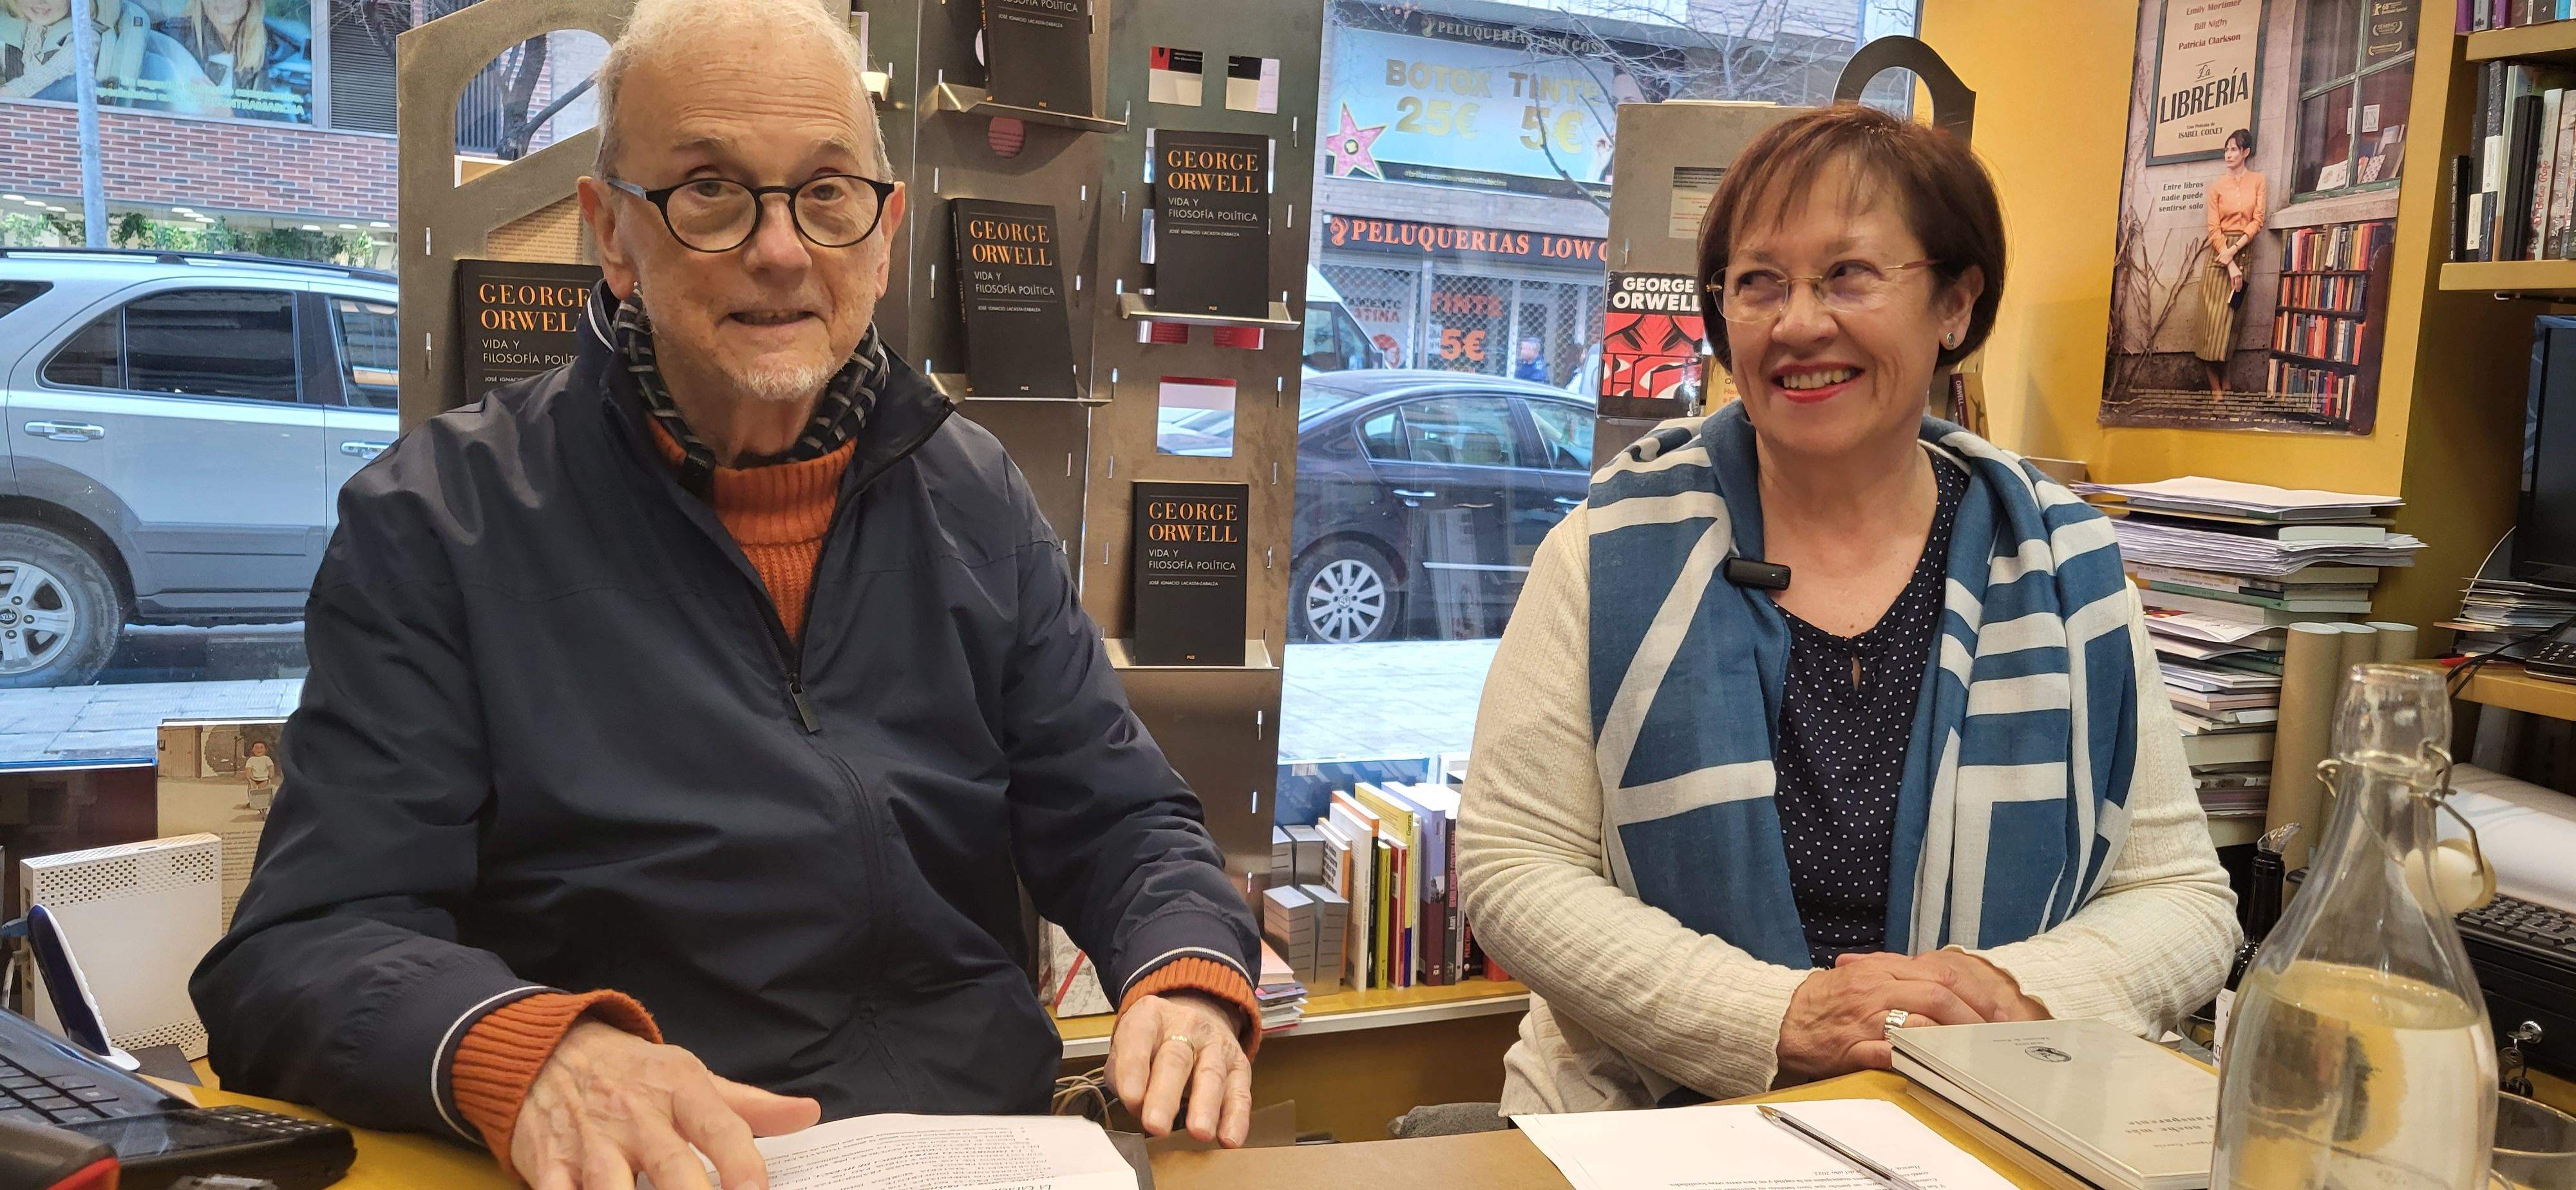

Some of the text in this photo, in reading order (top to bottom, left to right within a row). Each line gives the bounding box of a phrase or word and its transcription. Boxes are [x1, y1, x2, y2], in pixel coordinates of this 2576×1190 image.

[1042, 0, 1079, 13] POLÍTICA
[2186, 0, 2242, 15] Emily Mortimer
[2194, 18, 2228, 31] Bill Nighy
[1571, 39, 1604, 54] COS
[2179, 33, 2241, 51] Patricia Clarkson
[2197, 64, 2211, 79] La
[1386, 59, 1602, 108] BOTOX TINTE
[2159, 66, 2249, 124] LIBRERÍA
[1396, 96, 1585, 155] 25€ 5€
[2179, 127, 2224, 139] ISABEL COIXET
[1168, 150, 1258, 172] GEORGE
[1168, 172, 1259, 194] ORWELL
[1168, 197, 1198, 207] VIDA Y
[2183, 191, 2203, 201] puede
[1168, 209, 1258, 222] FILOSOFÍA POLÍTICA
[970, 220, 1050, 243] GEORGE
[1351, 218, 1530, 256] PELUQUERIAS
[1541, 236, 1595, 261] LOW
[972, 243, 1052, 267] ORWELL
[974, 271, 1001, 281] VIDA Y
[1623, 276, 1695, 293] GEORGE
[976, 283, 1056, 296] FILOSOFÍA POLÍTICA
[1431, 290, 1503, 317] TINTE
[1613, 291, 1701, 312] ORWELL
[480, 309, 581, 332] ORWEL
[482, 339, 520, 349] VIDA Y
[1440, 328, 1486, 362] 5€
[483, 352, 574, 366] FILOSOFÍA POLÍT
[1955, 380, 1964, 406] ORWELL
[1149, 502, 1238, 522] GEORGE
[1149, 524, 1238, 543] ORWELL
[1149, 549, 1179, 558] VIDA Y
[1149, 560, 1236, 571] FILOSOFÍA POLÍTICA
